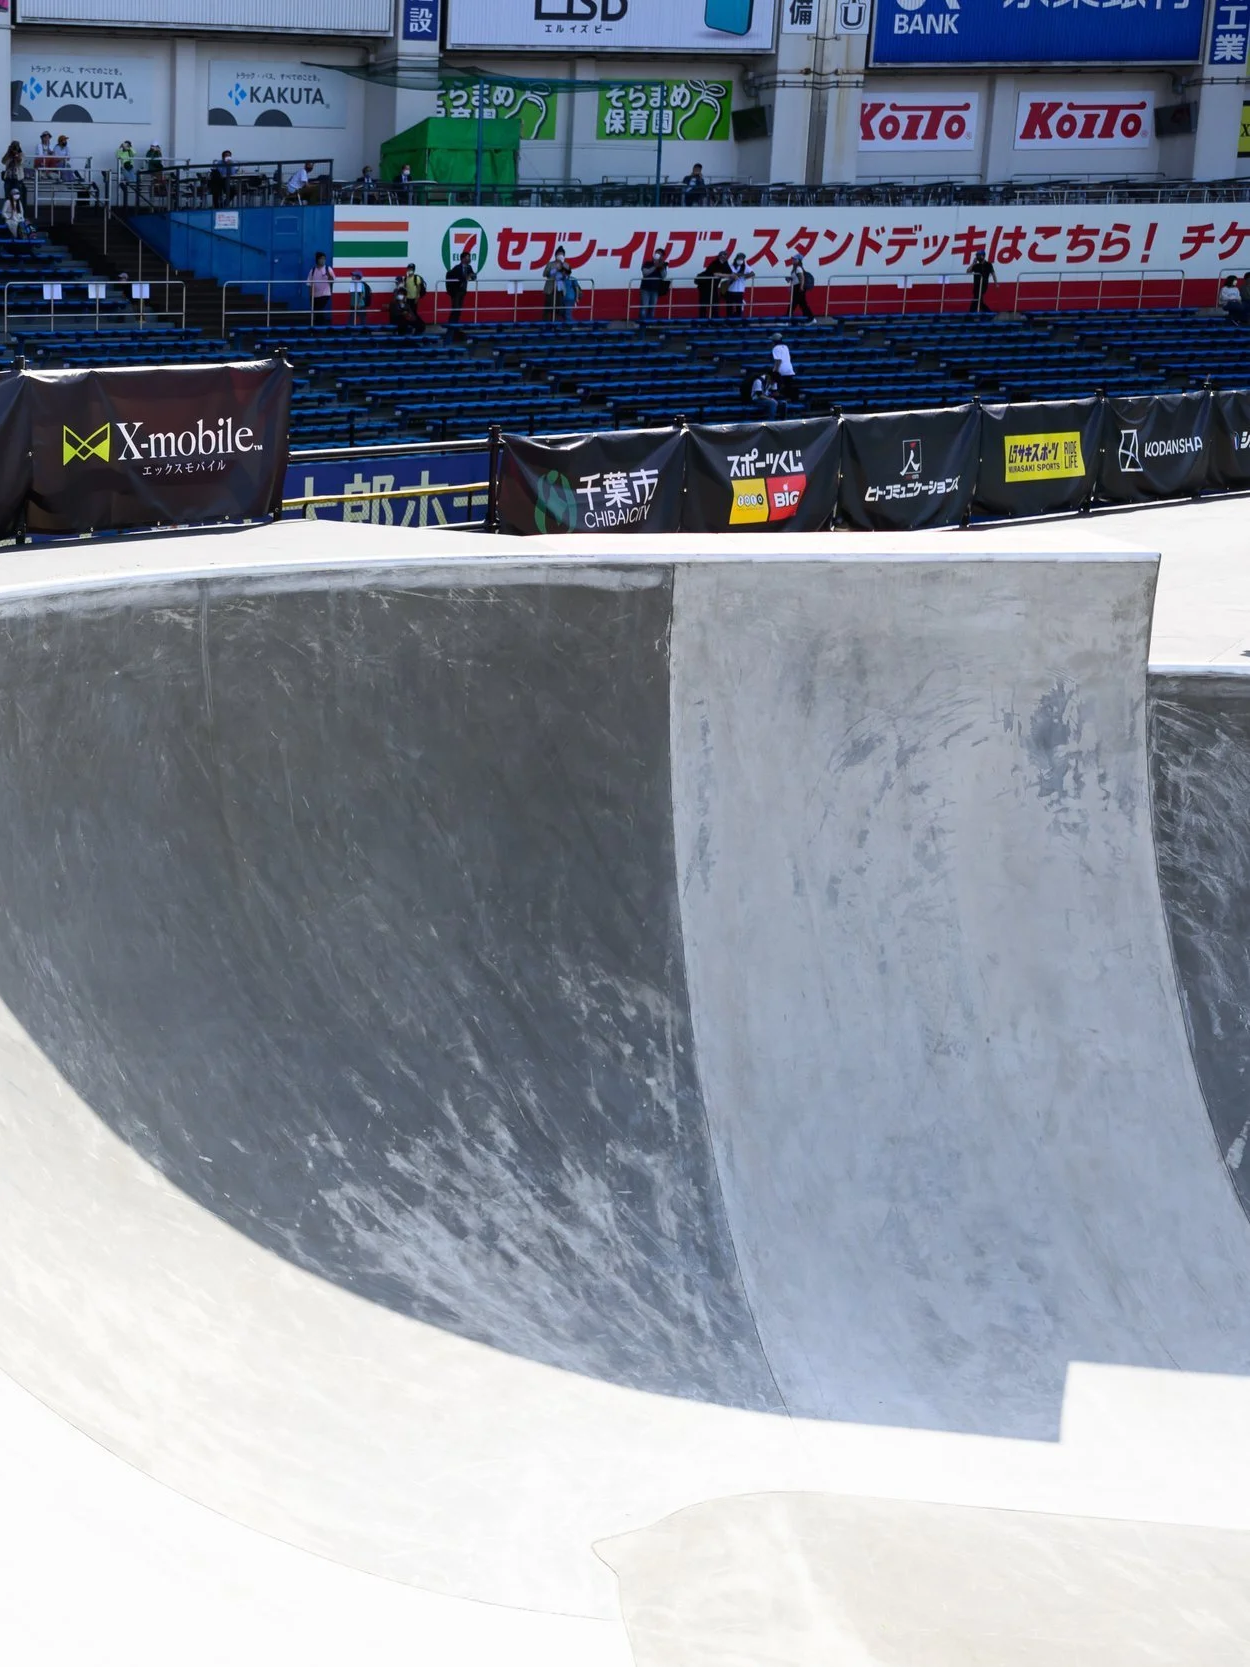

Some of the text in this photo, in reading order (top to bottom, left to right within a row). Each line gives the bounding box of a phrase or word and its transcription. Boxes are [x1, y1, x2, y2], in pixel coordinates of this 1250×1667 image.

[893, 13, 960, 35] BANK
[1213, 5, 1248, 61] 工業
[46, 80, 128, 100] KAKUTA
[250, 86, 326, 105] KAKUTA
[605, 84, 691, 108] そらまめ
[604, 108, 674, 135] 保育園
[115, 416, 254, 461] X-mobile
[1063, 440, 1078, 455] RIDE
[1144, 435, 1204, 458] KODANSHA
[142, 459, 227, 476] エックスモバイル
[726, 447, 805, 478] スポーツくじ
[1008, 462, 1061, 474] MURASAKI SPORTS
[1064, 454, 1079, 469] LIFE
[576, 468, 659, 511] 千葉市
[773, 483, 800, 508] BIG
[864, 475, 961, 502] ヒト・コミュニケーションズ
